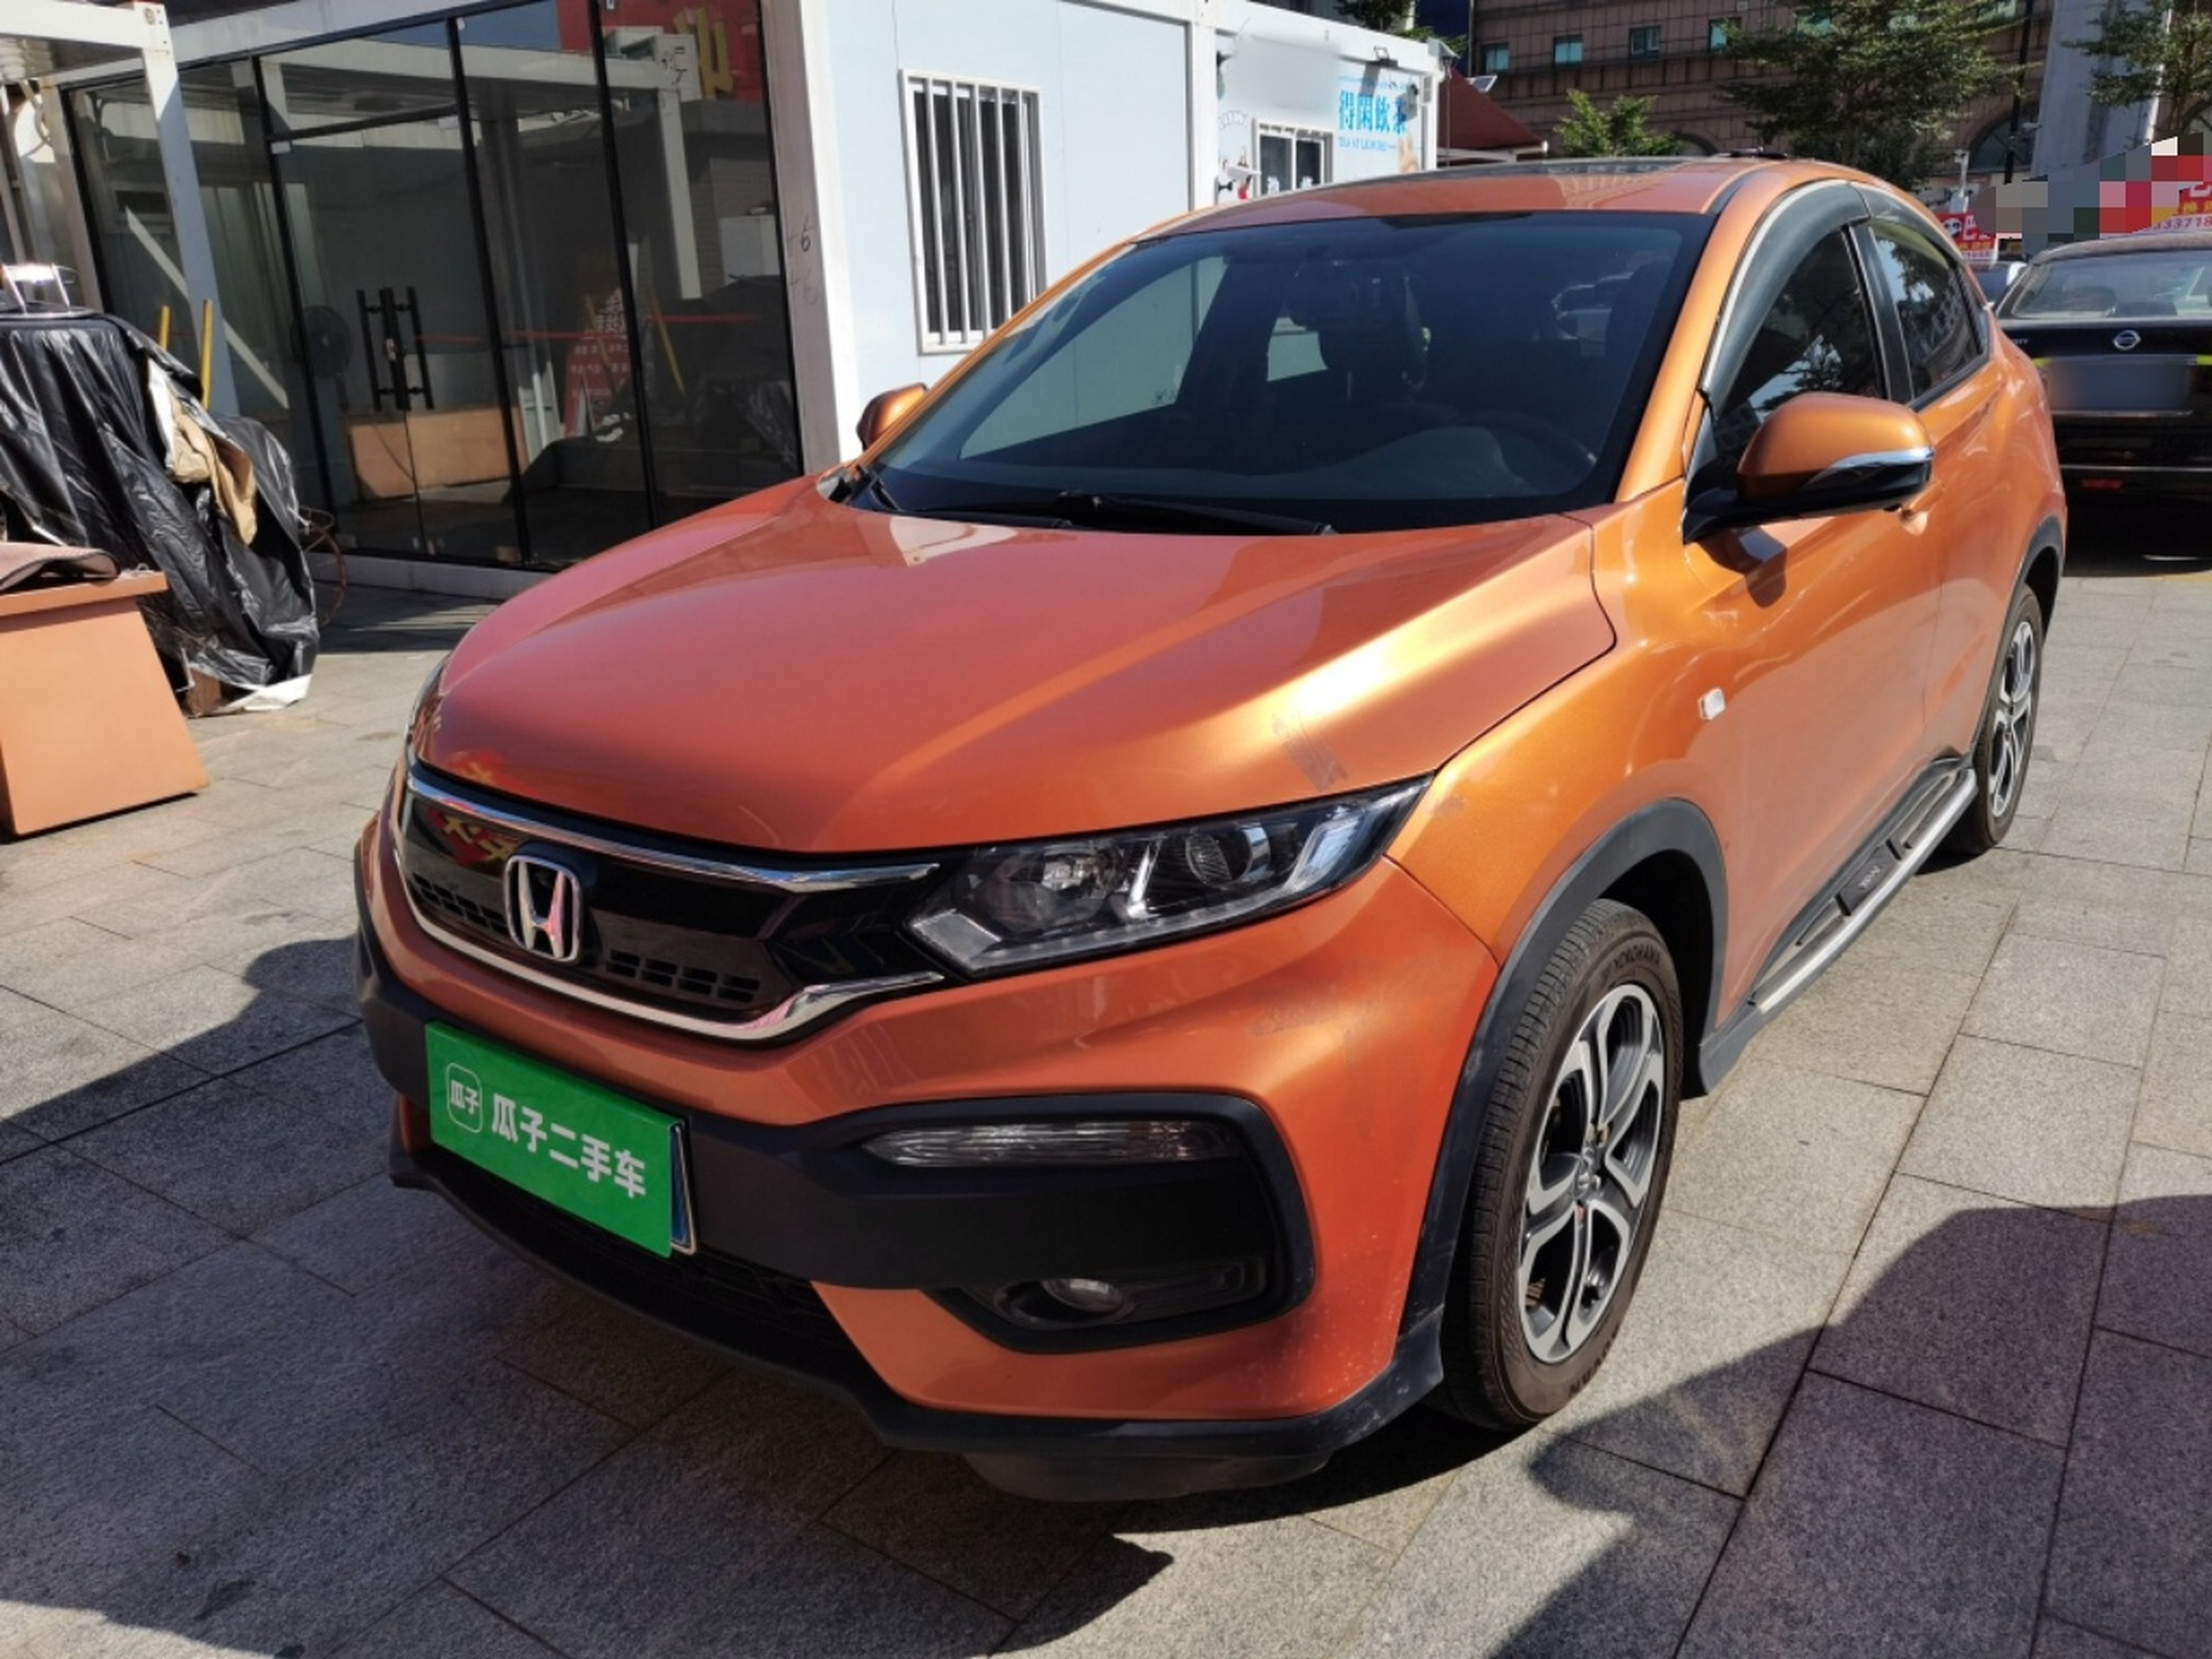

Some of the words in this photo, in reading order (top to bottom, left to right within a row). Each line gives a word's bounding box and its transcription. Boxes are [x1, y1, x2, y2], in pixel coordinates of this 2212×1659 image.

[450, 1080, 479, 1115] 瓜子
[492, 1093, 646, 1198] 瓜子二手车
